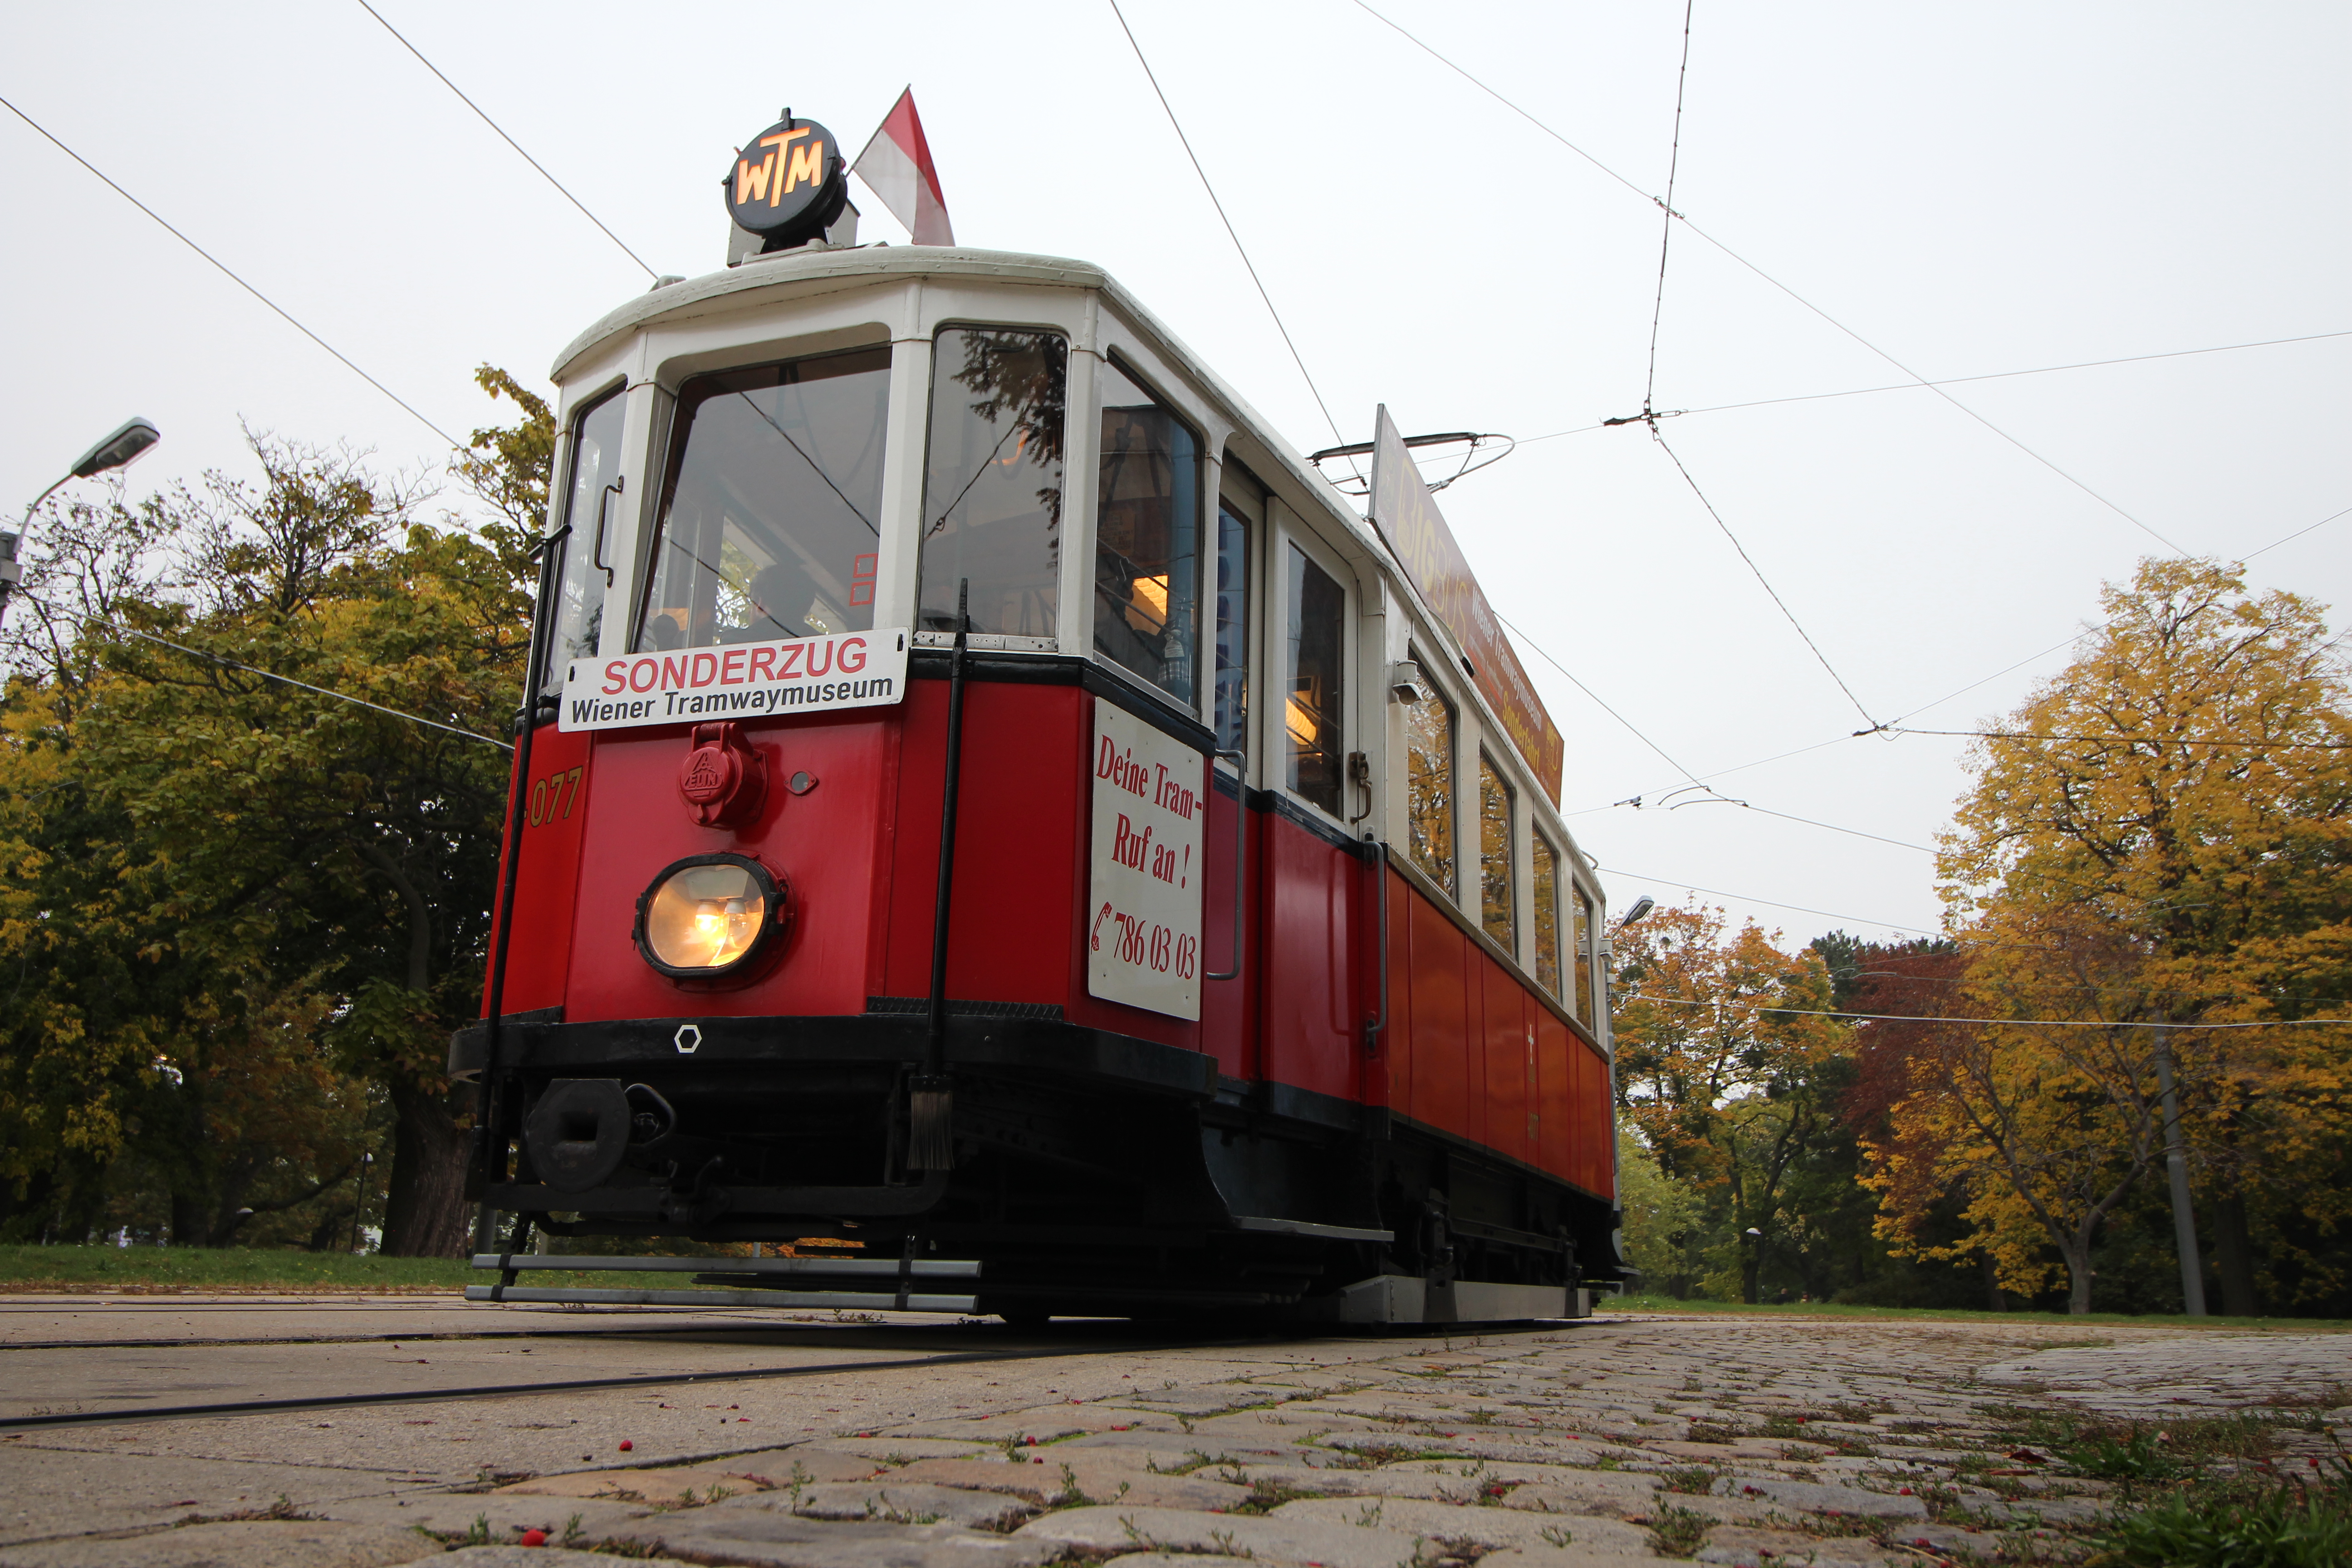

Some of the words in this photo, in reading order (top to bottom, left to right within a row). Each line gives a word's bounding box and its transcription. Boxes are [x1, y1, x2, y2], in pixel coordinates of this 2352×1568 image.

[736, 126, 823, 208] WTM
[601, 637, 867, 696] SONDERZUG
[1472, 585, 1494, 647] Wiener
[1494, 627, 1543, 732] Tramwaymuseum
[572, 698, 656, 724] Wiener
[664, 677, 893, 716] Tramwaymuseum
[1502, 690, 1540, 773] Sonderfahrt
[524, 765, 583, 828] 077
[688, 773, 718, 789] ELIN
[1096, 735, 1149, 798] Deine
[1154, 763, 1203, 820] Tram-
[1112, 813, 1152, 872] Ruf
[1114, 912, 1147, 966] 786
[1150, 924, 1171, 973] 03
[1176, 933, 1196, 980] 03
